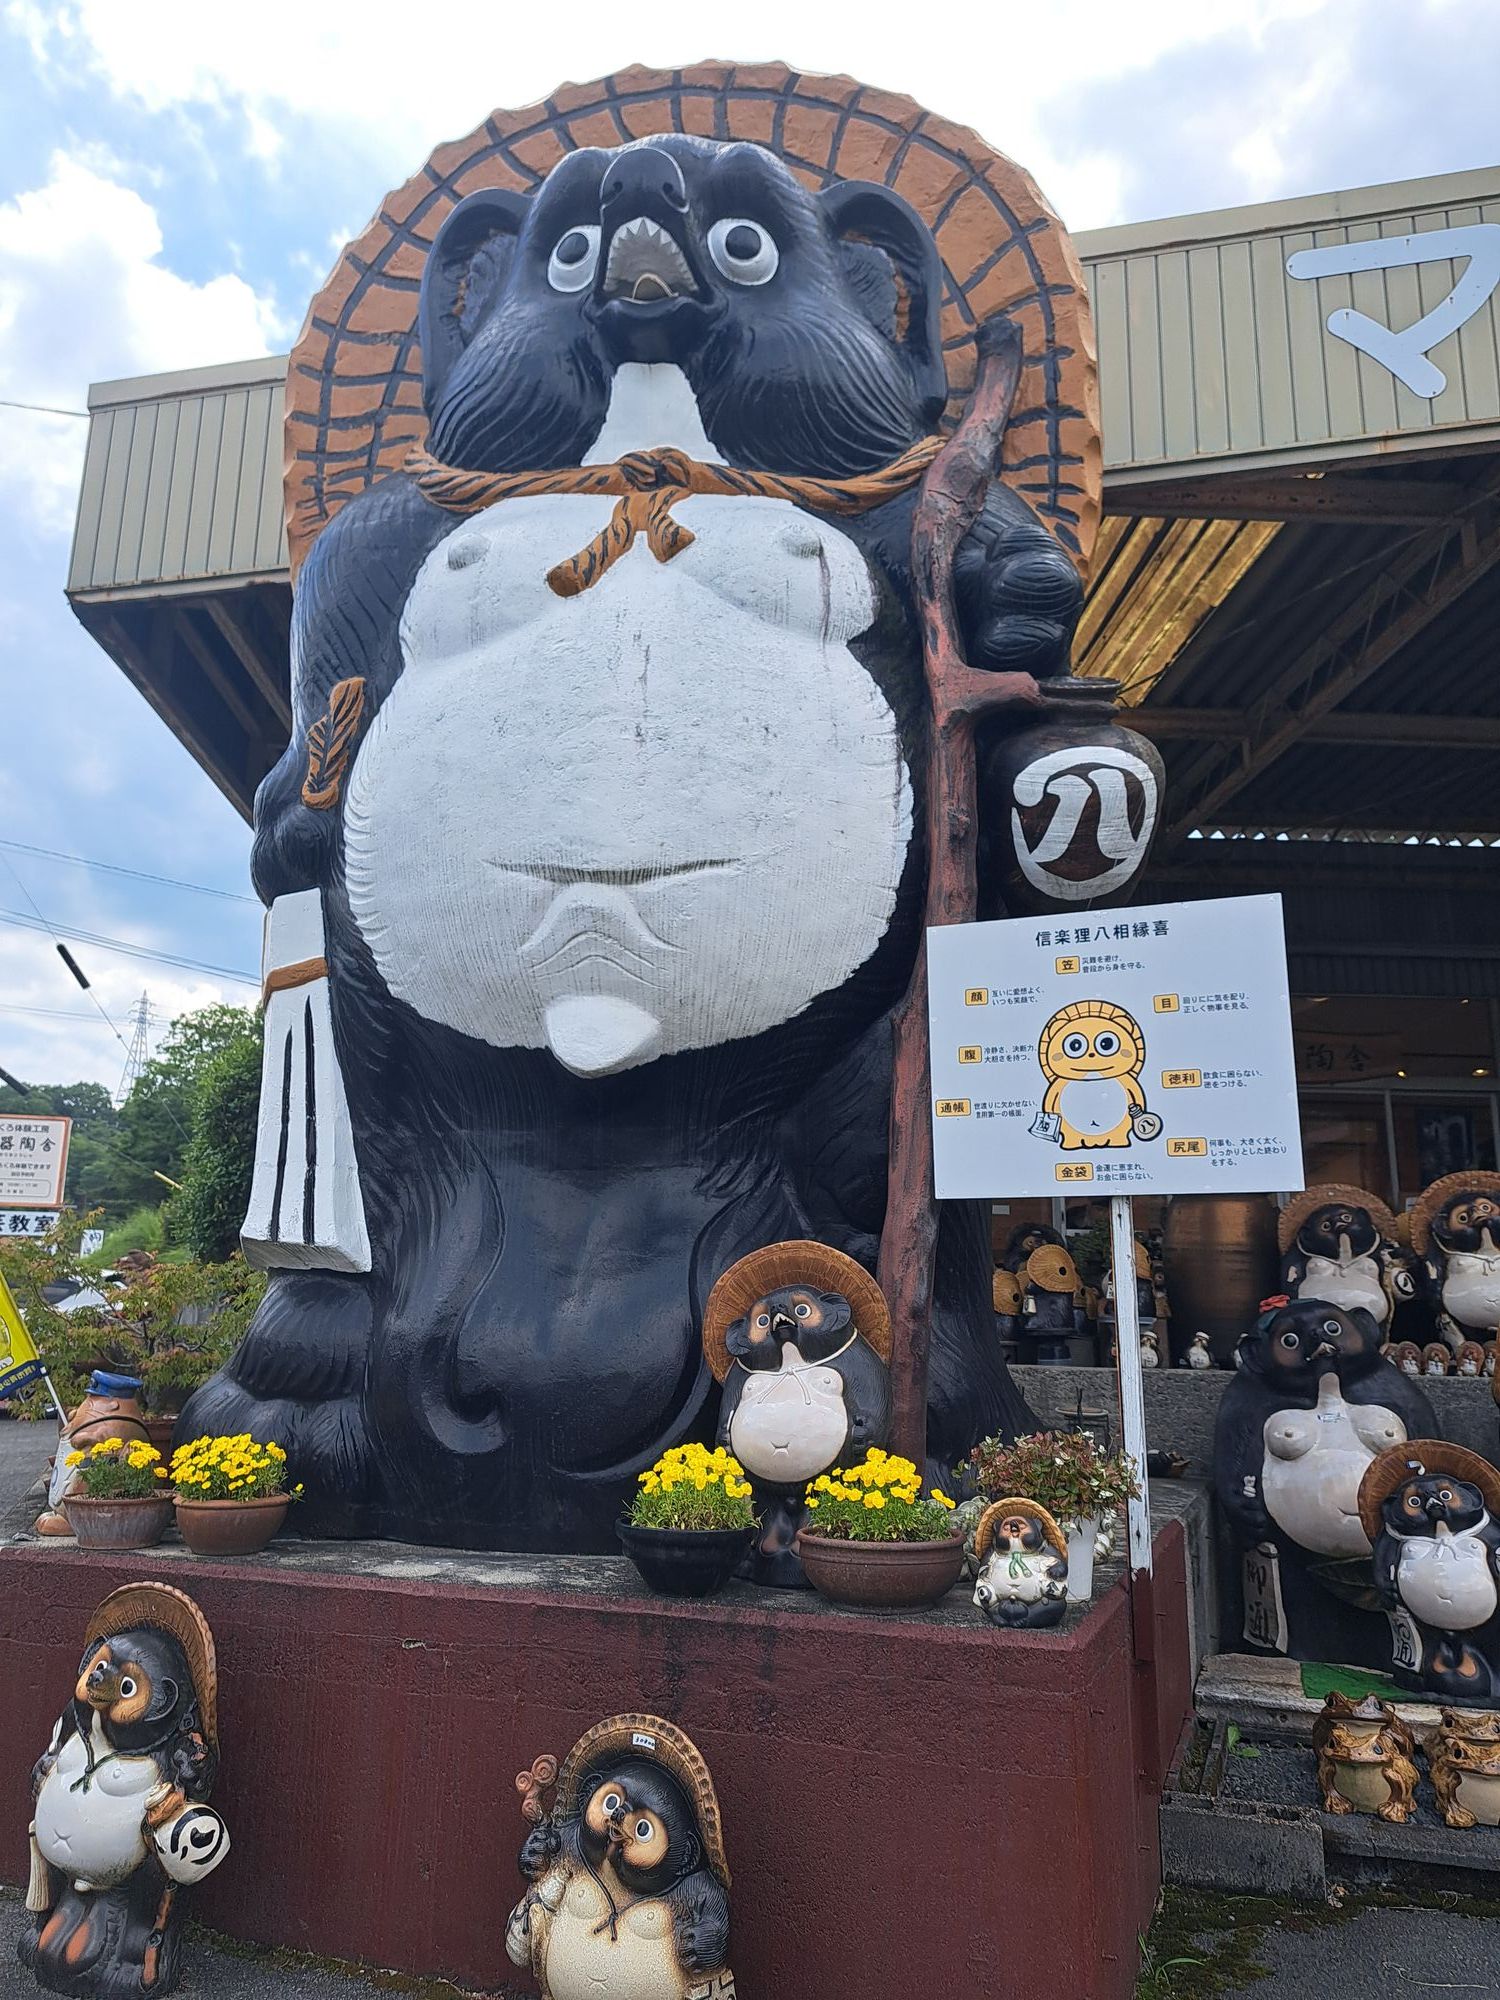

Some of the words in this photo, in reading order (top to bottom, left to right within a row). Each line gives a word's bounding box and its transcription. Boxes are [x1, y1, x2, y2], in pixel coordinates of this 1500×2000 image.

[1035, 919, 1170, 947] 信楽狸八相縁喜
[1061, 959, 1074, 971] 笠
[970, 991, 983, 1002] 顔
[1161, 998, 1171, 1009] 目
[964, 1049, 976, 1060] 腹
[1168, 1073, 1195, 1085] 徳利
[940, 1102, 965, 1113] 通帳
[1173, 1141, 1200, 1153] 尻尾
[1061, 1166, 1087, 1178] 金袋
